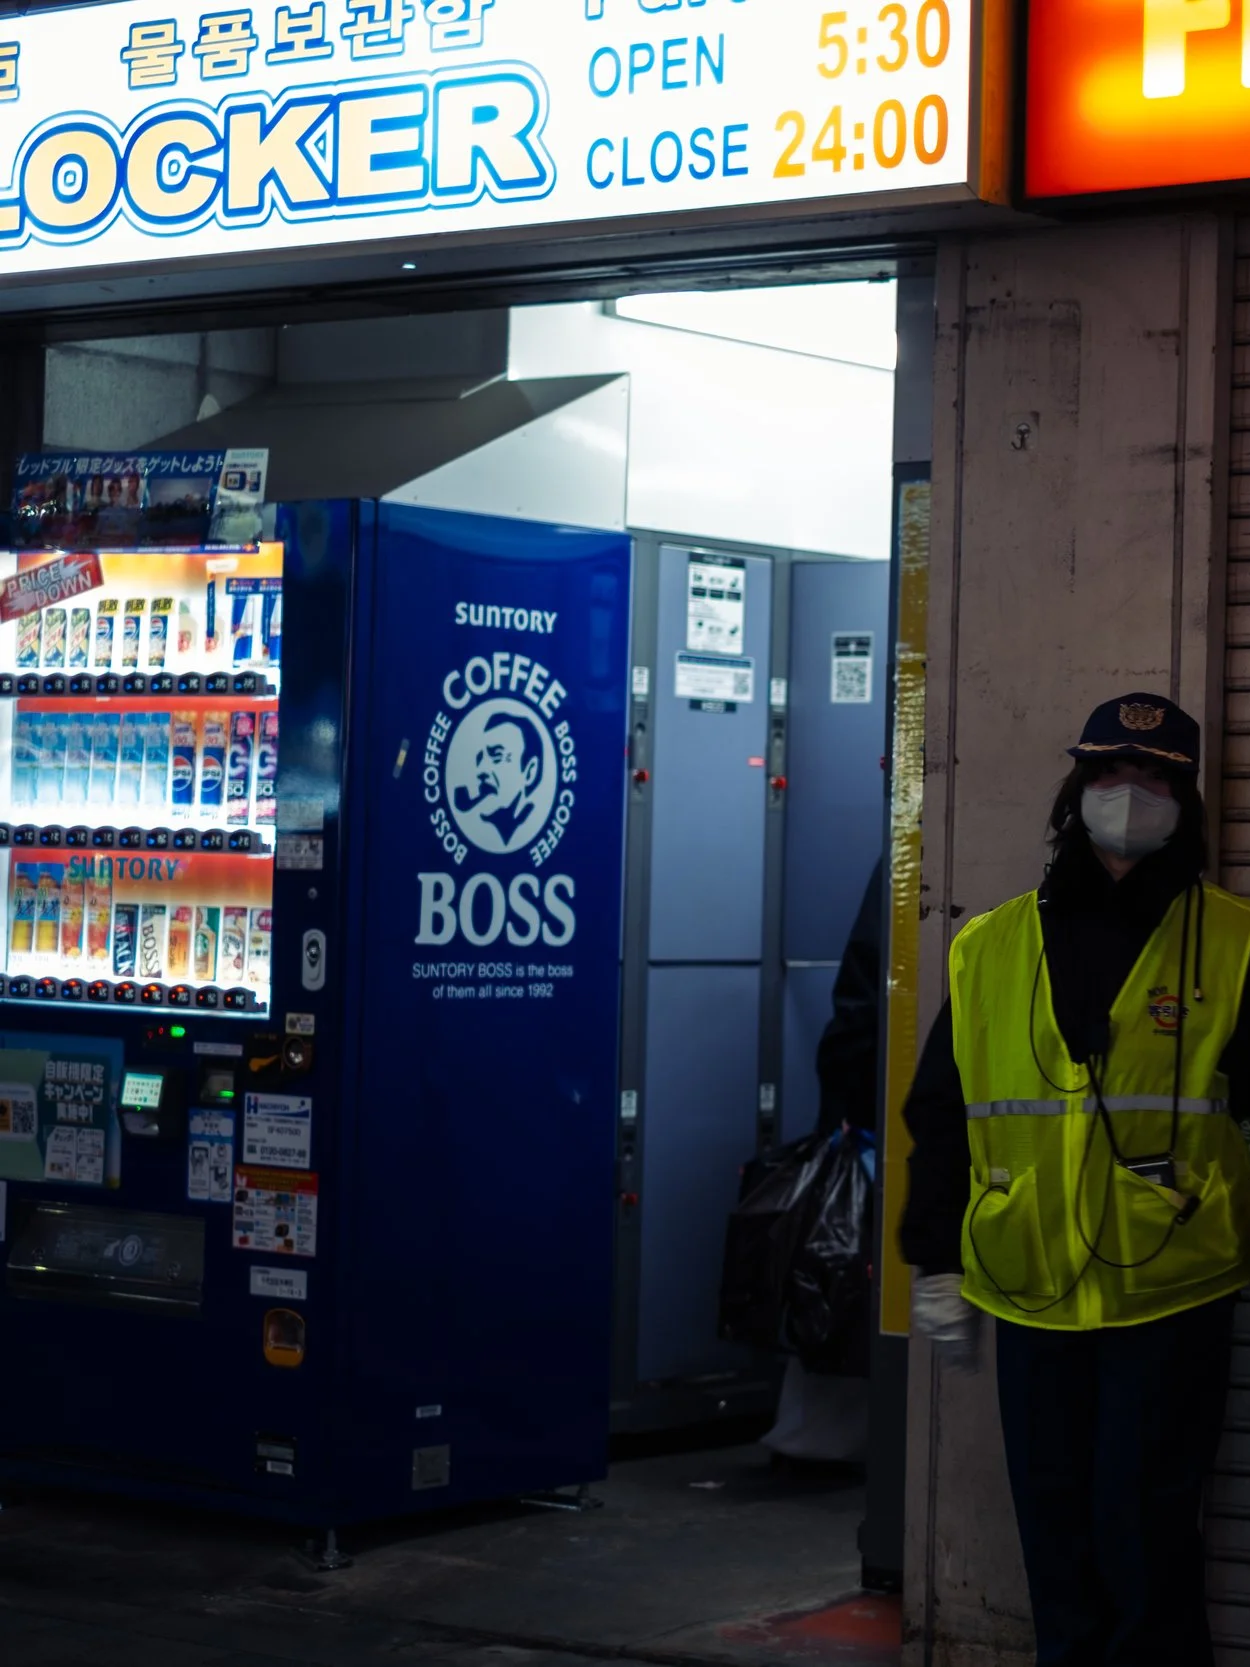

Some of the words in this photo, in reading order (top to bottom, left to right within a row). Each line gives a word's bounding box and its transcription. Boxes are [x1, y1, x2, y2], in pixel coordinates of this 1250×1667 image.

[121, 0, 496, 90] 물품보관함
[588, 33, 725, 98] OPEN
[816, 0, 951, 80] 5:30
[0, 64, 552, 244] OCKER
[586, 123, 750, 190] CLOSE
[773, 94, 950, 179] 24:00
[7, 561, 61, 599] PRICE
[35, 569, 93, 608] DOWN
[455, 601, 557, 634] SUNTORY
[442, 651, 568, 720] COFFEE
[423, 711, 453, 803] COFFEE
[554, 720, 577, 783] BOSS
[430, 808, 468, 865] BOSS
[529, 789, 575, 868] COFFEE
[68, 854, 180, 882] SUNTORY
[414, 871, 577, 947] BOSS
[141, 923, 161, 974] BOSS
[412, 962, 475, 979] SUNTORY
[478, 962, 513, 979] BOSS
[515, 963, 525, 978] is
[528, 963, 544, 978] the
[547, 963, 574, 979] boss
[433, 984, 446, 1000] of
[447, 984, 476, 999] them
[478, 984, 493, 999] all
[495, 984, 524, 999] since
[528, 983, 554, 998] 1992
